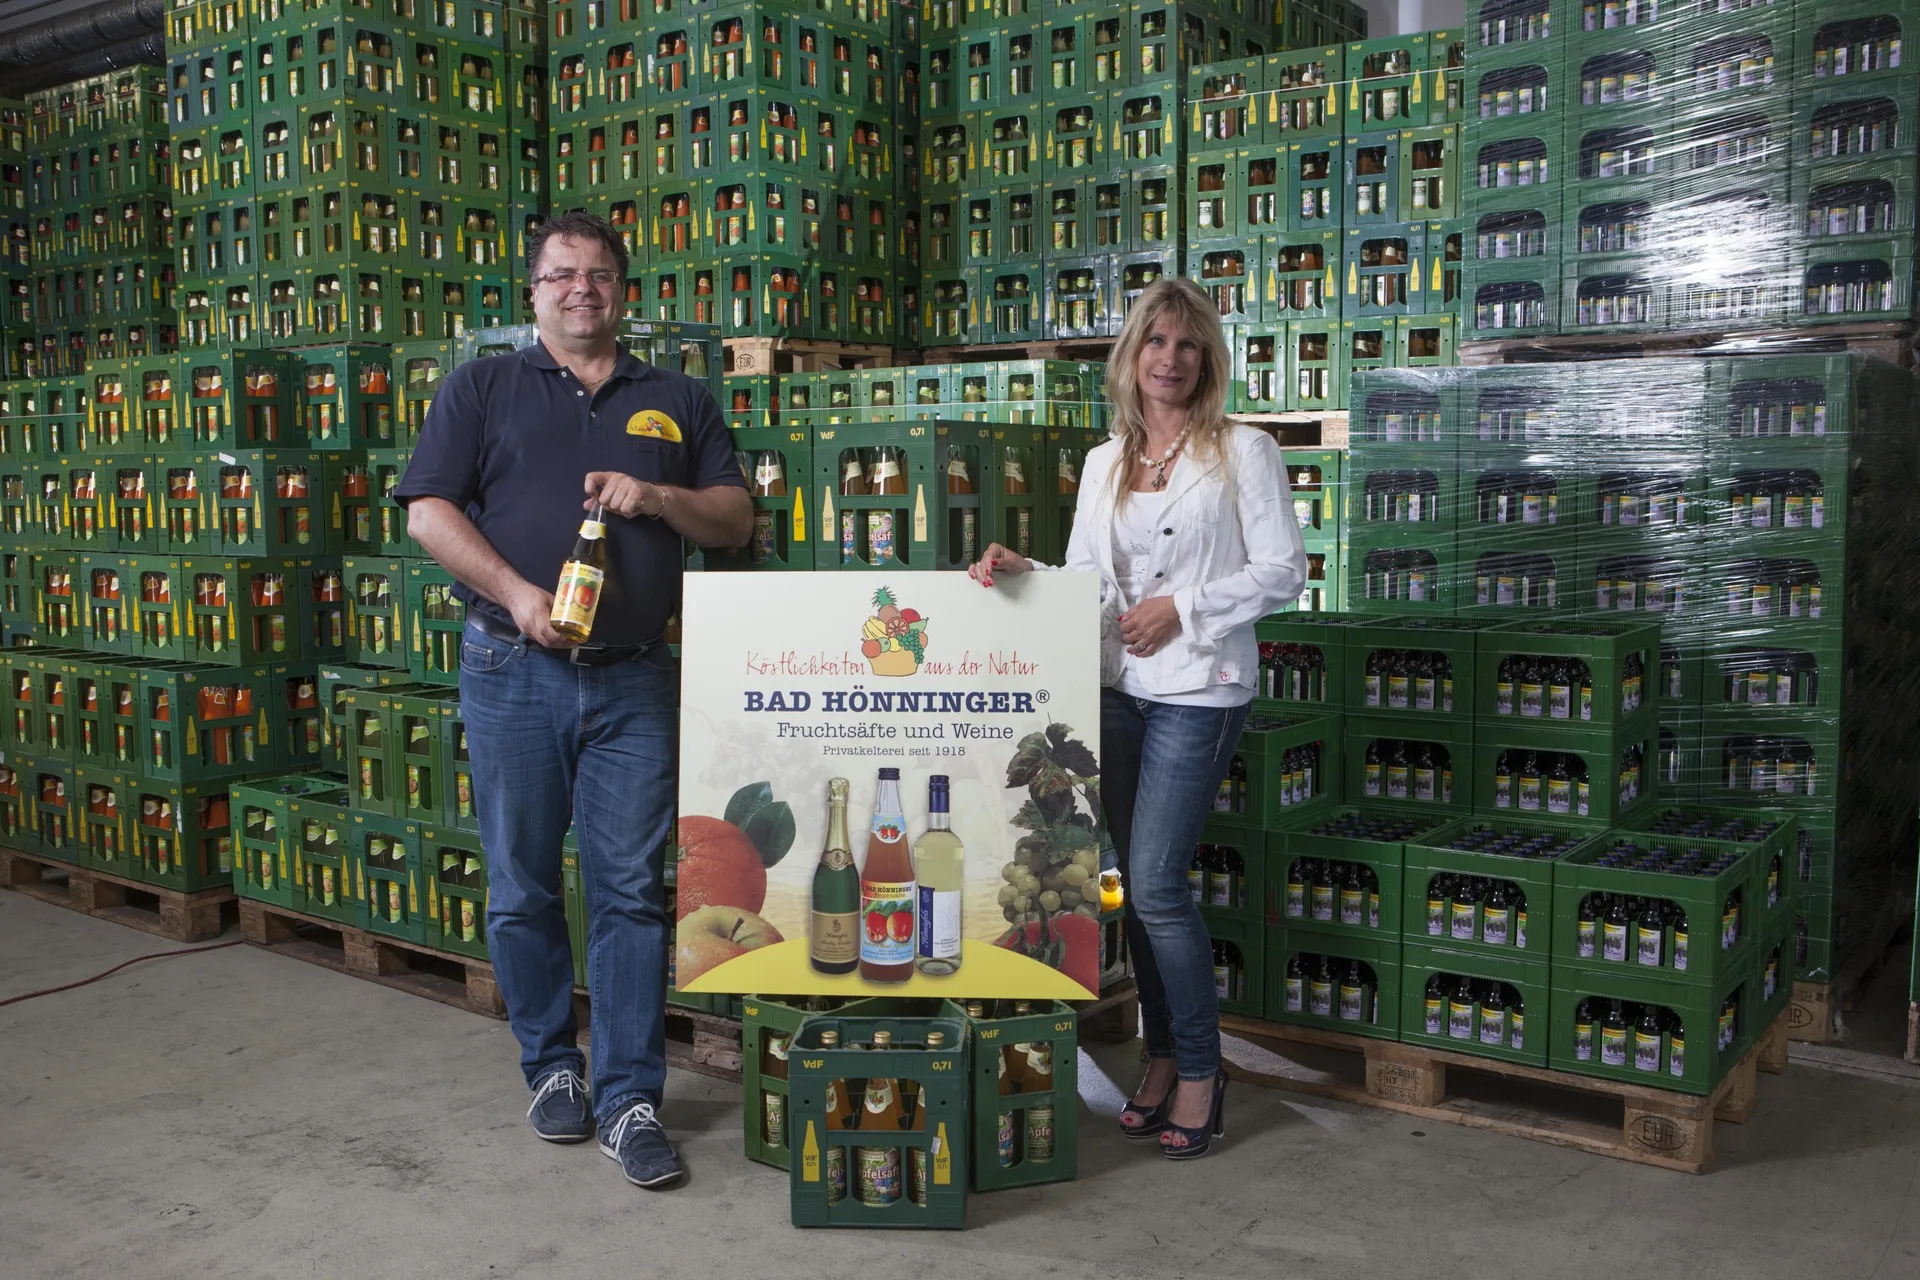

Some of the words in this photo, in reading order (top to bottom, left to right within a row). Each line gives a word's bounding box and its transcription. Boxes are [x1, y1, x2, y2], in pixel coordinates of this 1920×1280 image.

[739, 357, 752, 368] EUR
[820, 431, 835, 440] VdF
[746, 650, 866, 675] Köstlichkeiten
[924, 661, 953, 675] aus
[958, 650, 983, 675] der
[989, 650, 1039, 676] Natur
[744, 691, 811, 712] BAD
[777, 722, 897, 739] Fruchtsäfte
[904, 723, 945, 739] und
[951, 723, 1014, 739] Weine
[823, 746, 905, 756] Privatkelterei
[909, 747, 930, 756] seit
[935, 747, 966, 756] 1918
[745, 1006, 758, 1016] VdF
[980, 1029, 1000, 1039] VdF
[803, 1059, 824, 1069] VdF
[1643, 1120, 1674, 1145] EUR
